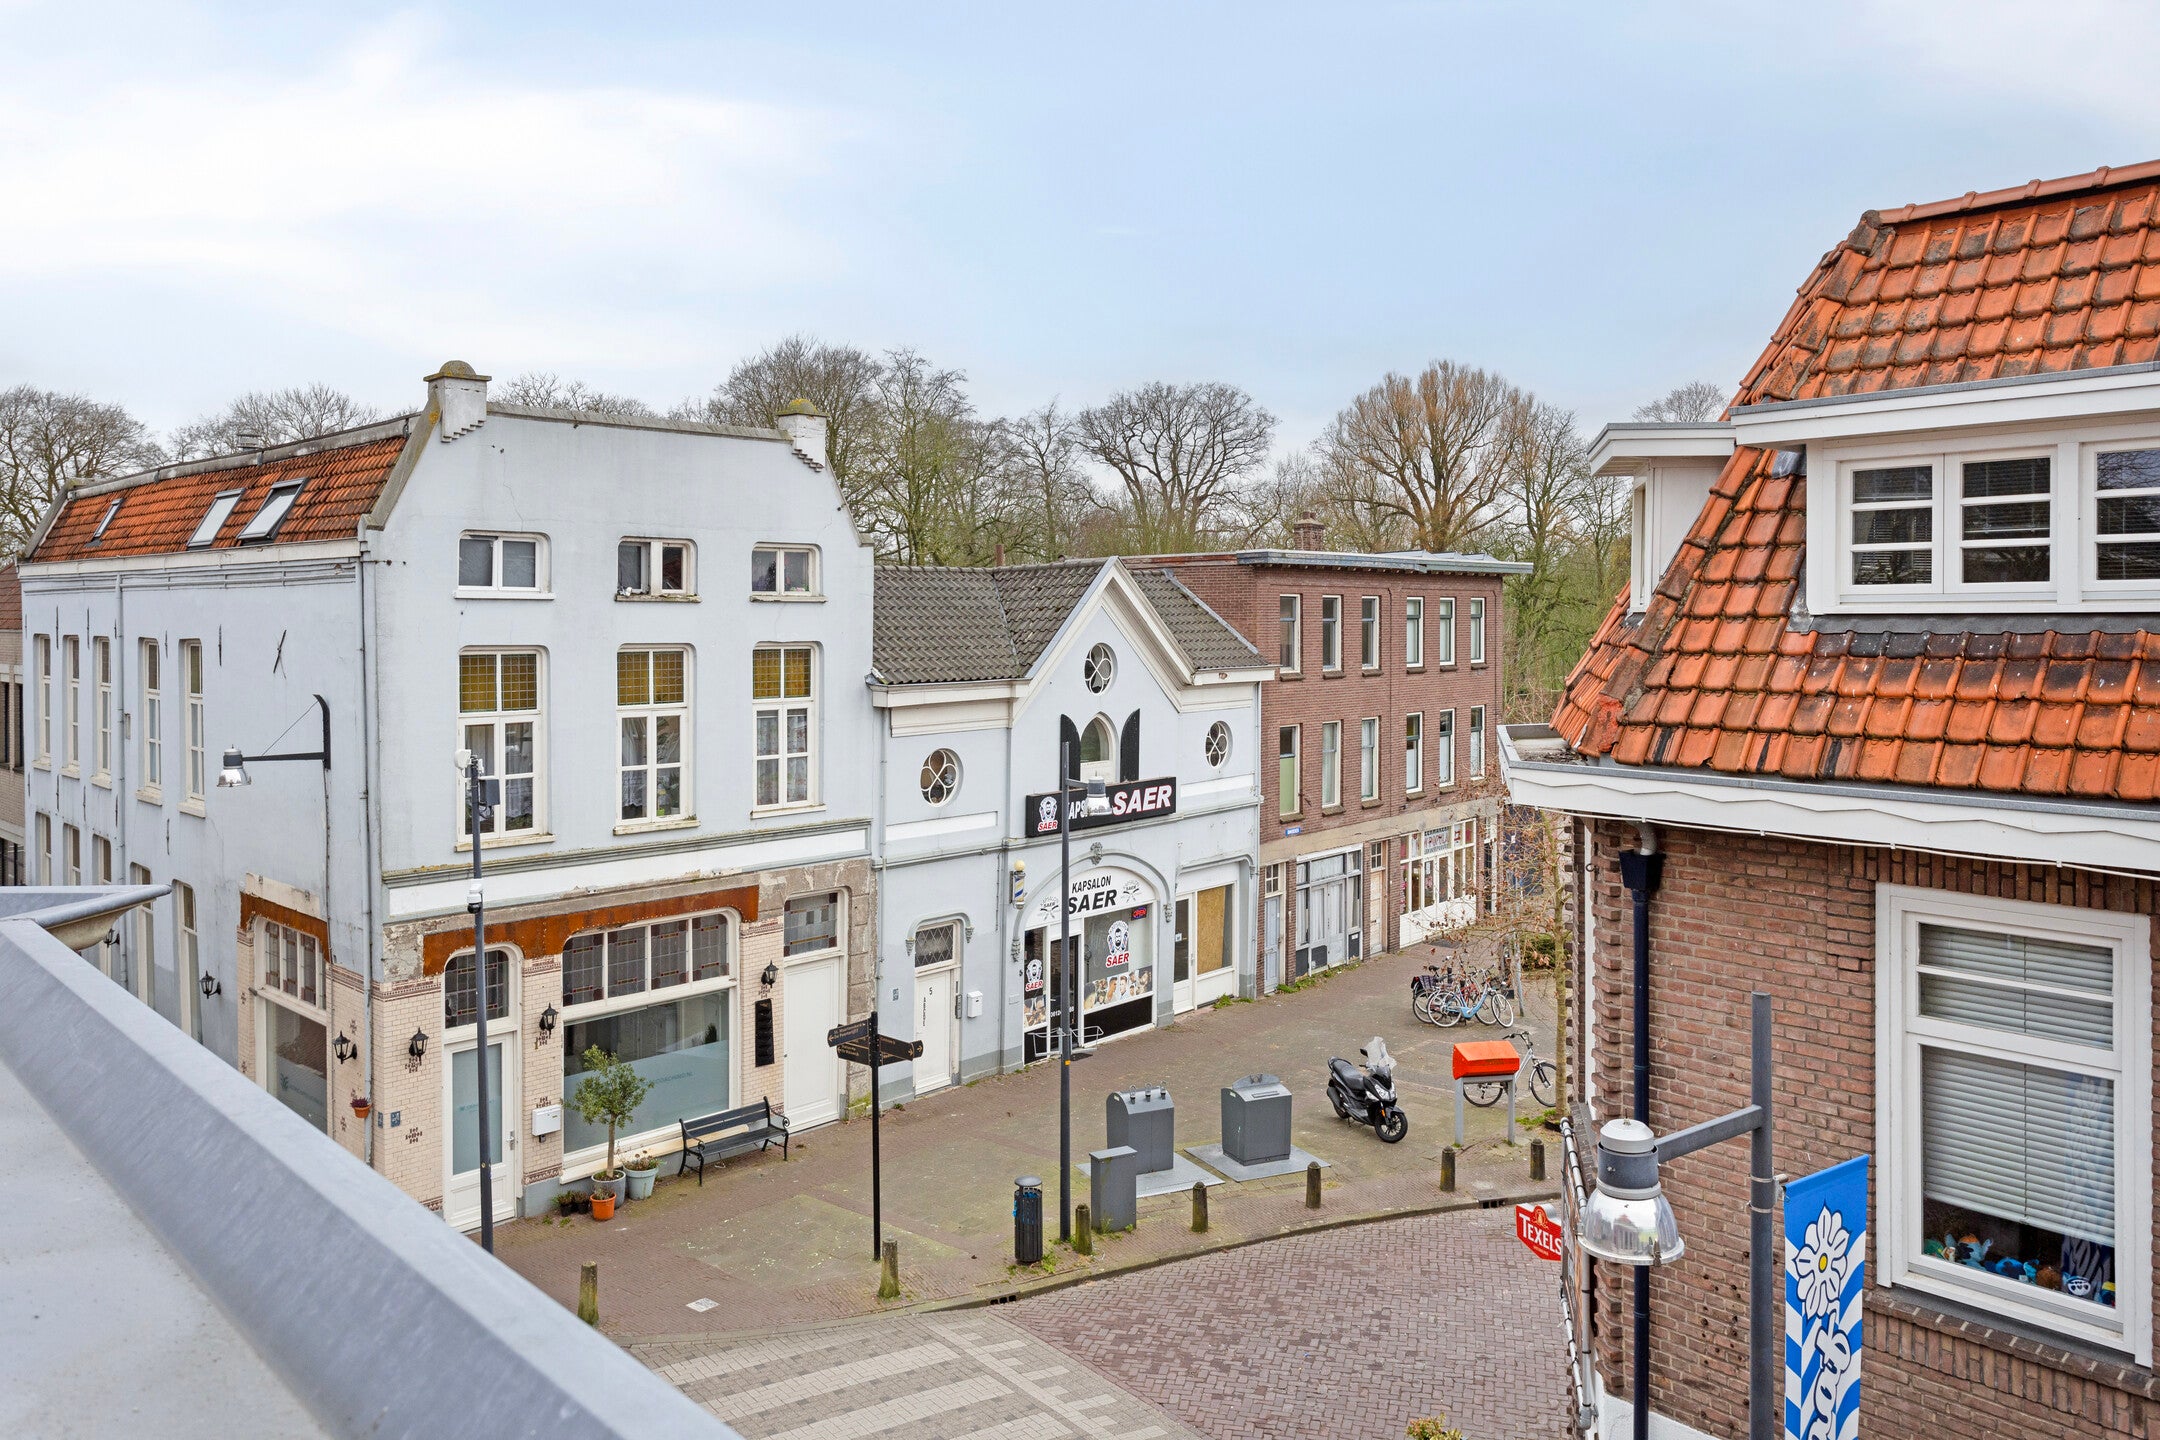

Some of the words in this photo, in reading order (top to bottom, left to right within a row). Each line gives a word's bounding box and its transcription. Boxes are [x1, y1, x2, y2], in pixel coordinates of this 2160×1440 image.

[1112, 784, 1172, 817] SAER
[1038, 820, 1058, 832] SAER
[1071, 875, 1112, 894] KAPSALON
[1069, 889, 1118, 915] SAER
[1106, 952, 1130, 967] SAER
[1025, 980, 1043, 991] SAER
[1518, 1212, 1562, 1256] TEXELS
